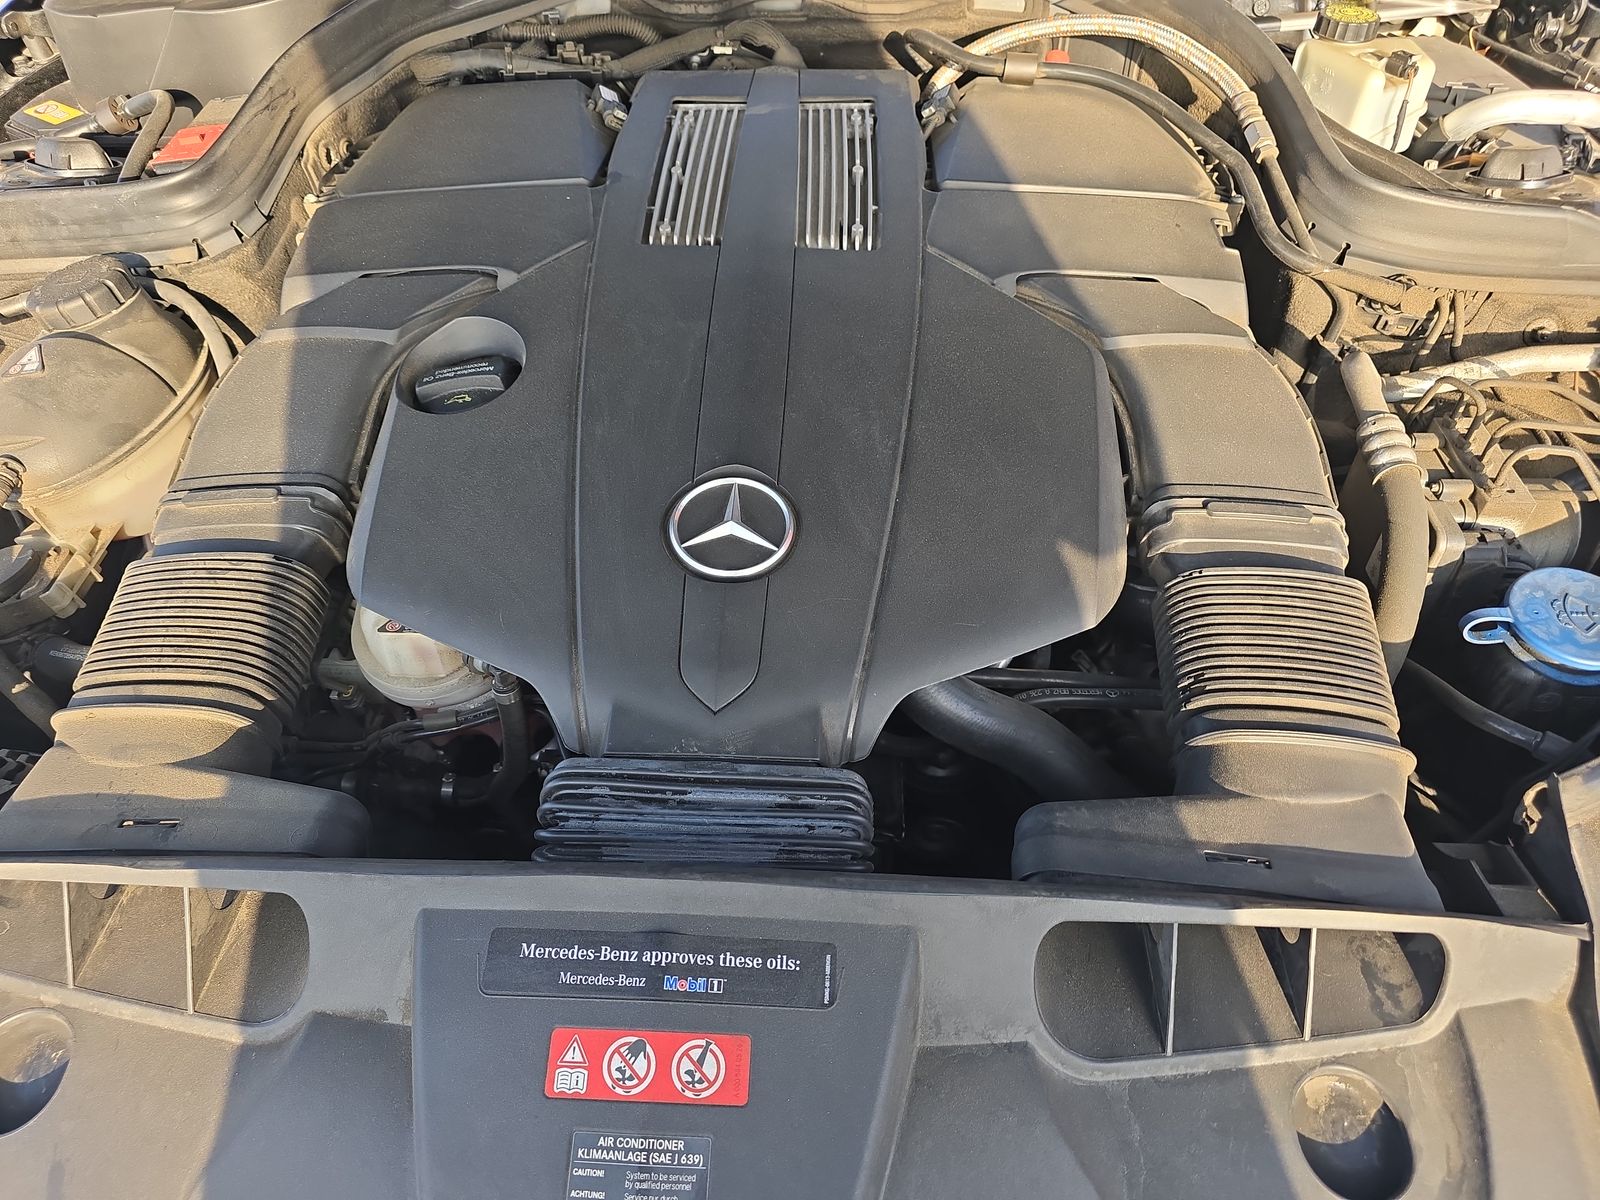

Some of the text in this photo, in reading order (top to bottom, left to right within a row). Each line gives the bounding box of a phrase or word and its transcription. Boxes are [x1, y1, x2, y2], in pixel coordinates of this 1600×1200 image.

[519, 943, 801, 971] Mercedes-Benz approves these oils:
[558, 972, 646, 987] Mercedes-Benz
[663, 975, 707, 993] Mobil
[598, 1136, 684, 1151] AIR CONDITIONER
[578, 1148, 703, 1167] KLIMAANLAGE (SAE J 639)
[573, 1168, 605, 1177] CAUTION!
[626, 1171, 696, 1182] System to be serviced
[625, 1180, 692, 1191] by qualified personnel
[570, 1190, 605, 1199] ACHTUNG!
